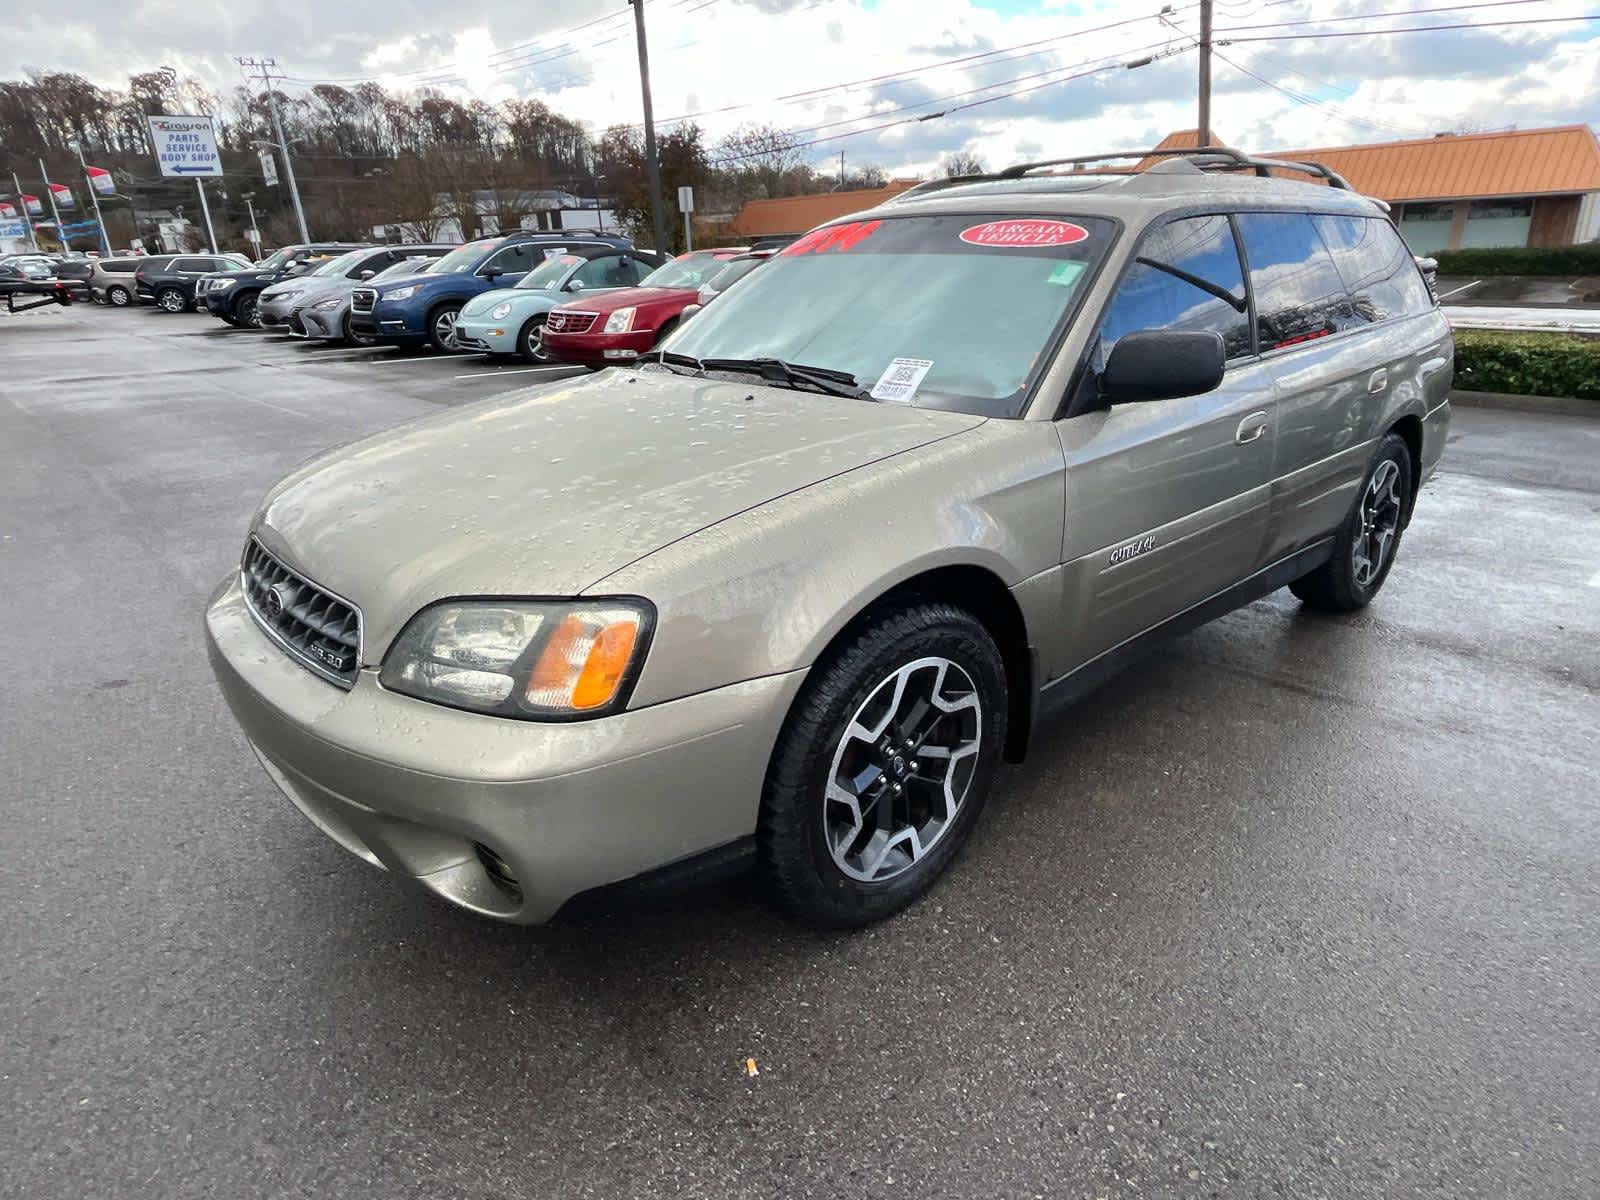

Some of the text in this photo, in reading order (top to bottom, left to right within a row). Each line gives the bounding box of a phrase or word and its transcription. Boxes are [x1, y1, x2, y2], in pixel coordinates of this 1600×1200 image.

[168, 134, 200, 143] PARTS
[165, 143, 208, 152] SERVICE
[160, 153, 217, 162] BODY SHOP
[981, 224, 1069, 234] BARGAIN
[976, 233, 1064, 243] VEHICLE
